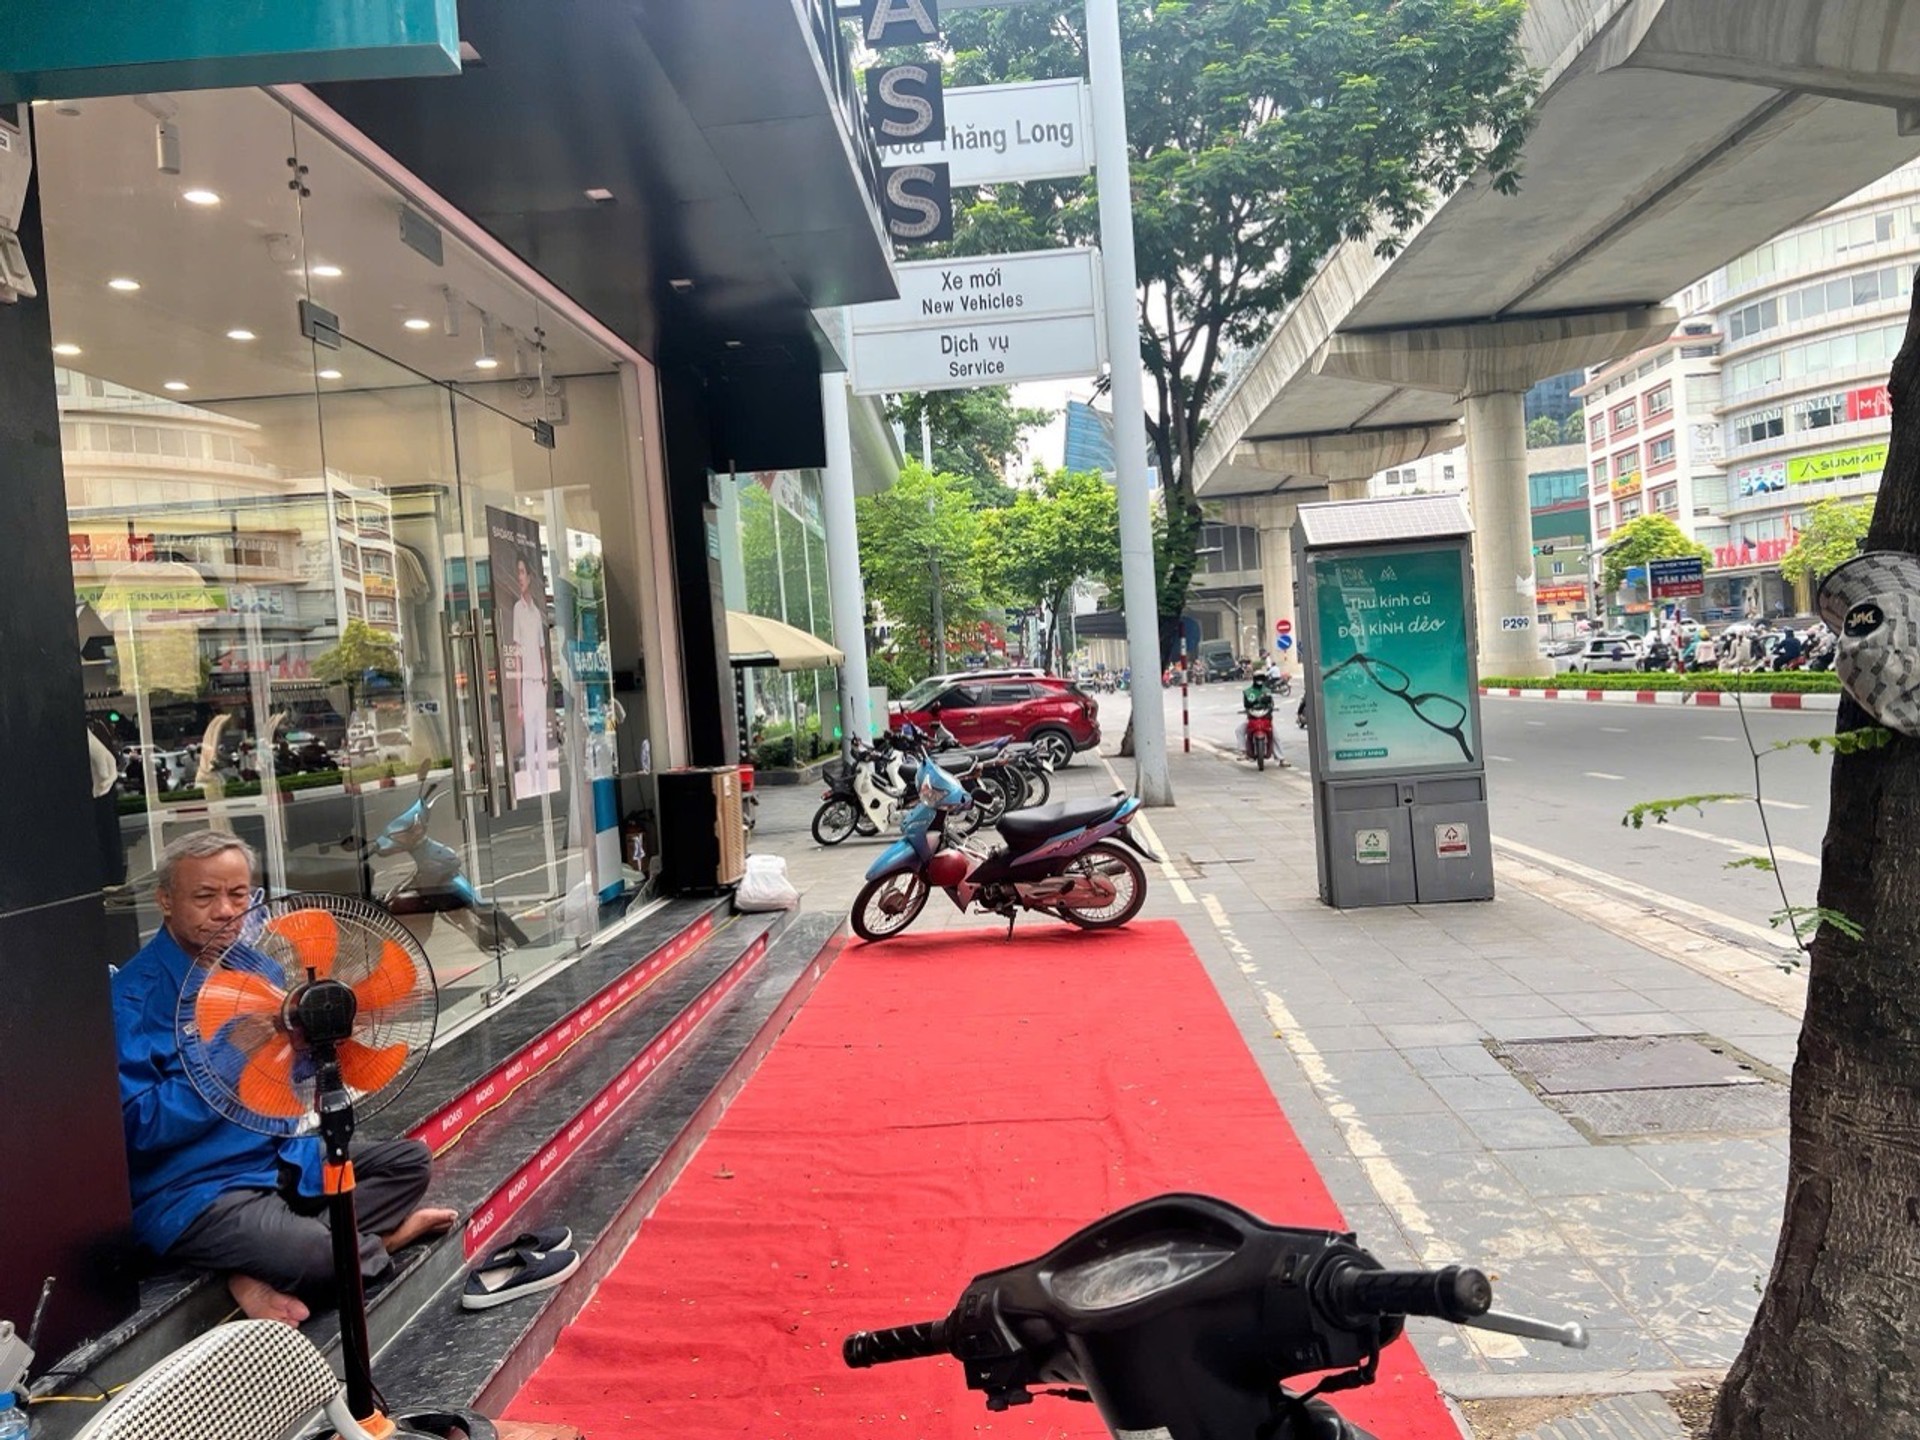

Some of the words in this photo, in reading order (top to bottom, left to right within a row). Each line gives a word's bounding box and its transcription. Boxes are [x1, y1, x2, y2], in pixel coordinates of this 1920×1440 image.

[1016, 119, 1073, 148] Long
[942, 271, 963, 291] Xe
[970, 268, 1002, 288] mới
[922, 298, 954, 315] New
[960, 293, 1023, 311] Vehicles
[941, 333, 978, 357] Dịch
[989, 335, 1010, 354] vụ
[949, 360, 1005, 377] Service
[1820, 452, 1884, 470] SUMMIT
[1379, 594, 1410, 608] kính
[1412, 592, 1431, 606] cũ
[1369, 620, 1404, 635] KÍNH
[1407, 615, 1446, 633] dẻo
[1502, 617, 1530, 630] P299
[472, 1208, 494, 1239] BADASS
